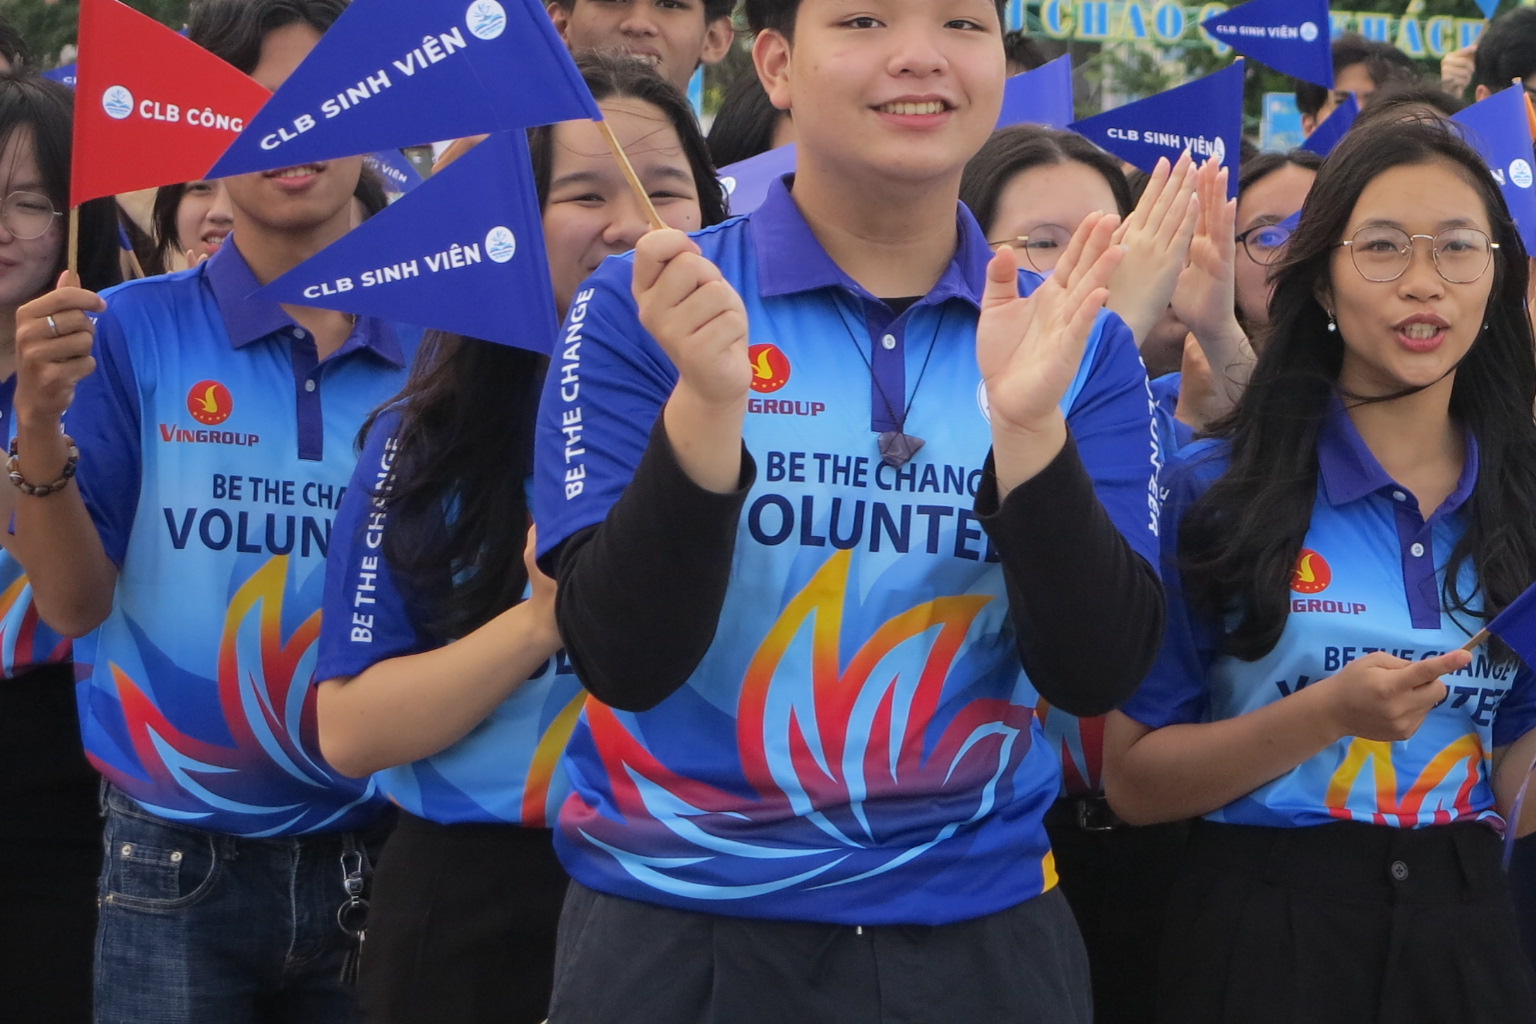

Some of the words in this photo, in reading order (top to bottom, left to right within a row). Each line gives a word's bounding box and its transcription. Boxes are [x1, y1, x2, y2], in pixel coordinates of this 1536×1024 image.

[1267, 24, 1298, 39] VIÊN
[260, 113, 316, 151] CLB
[321, 69, 392, 118] SINH
[393, 26, 468, 76] VIÊN
[139, 99, 180, 122] CLB
[1106, 128, 1139, 141] CLB
[1144, 131, 1180, 149] SINH
[1183, 135, 1214, 157] VIÊN
[303, 277, 354, 299] CLB
[361, 260, 420, 287] SINH
[424, 243, 482, 273] VIÊN
[561, 287, 596, 402] CHANGE
[748, 398, 826, 416] GROUP
[159, 423, 260, 447] VINGROUP
[561, 406, 586, 464] THE
[212, 473, 243, 501] BE
[249, 477, 296, 505] THE
[564, 463, 586, 501] BE
[766, 451, 806, 483] BE
[813, 452, 869, 488] THE
[875, 460, 984, 497] CHANG
[163, 507, 333, 558] VOLUN
[748, 493, 1000, 564] OLUNTE
[354, 556, 379, 608] THE
[1290, 599, 1367, 615] GROUP
[350, 611, 375, 643] BE
